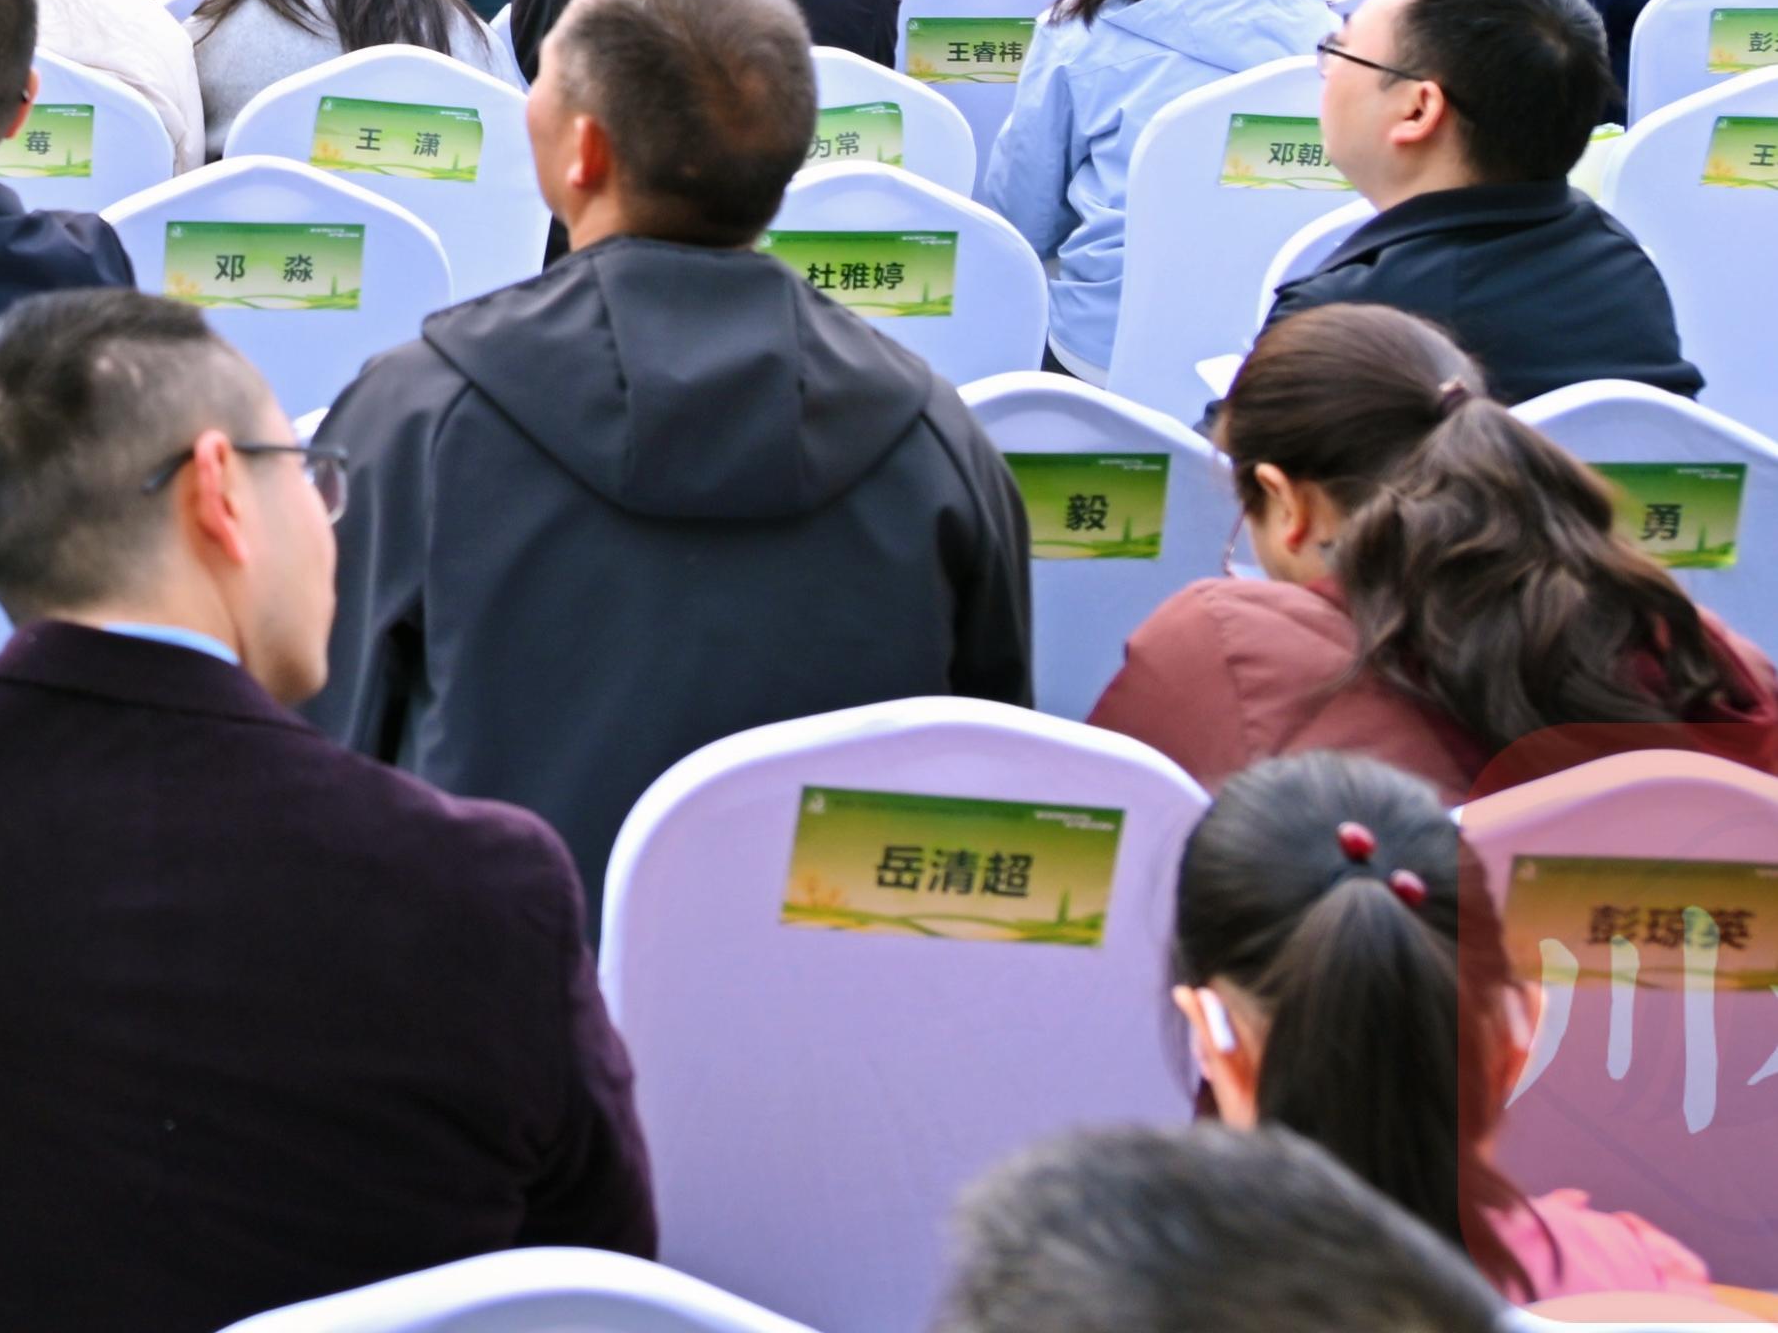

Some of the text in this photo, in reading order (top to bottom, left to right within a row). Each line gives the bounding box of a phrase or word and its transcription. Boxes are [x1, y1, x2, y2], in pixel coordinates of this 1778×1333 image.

[1748, 31, 1778, 53] 彭
[1267, 142, 1331, 167] 邓朝
[1749, 143, 1778, 167] 王
[807, 262, 905, 291] 杜雅婷
[1065, 493, 1109, 531] 毅
[875, 843, 1034, 898] 岳清超
